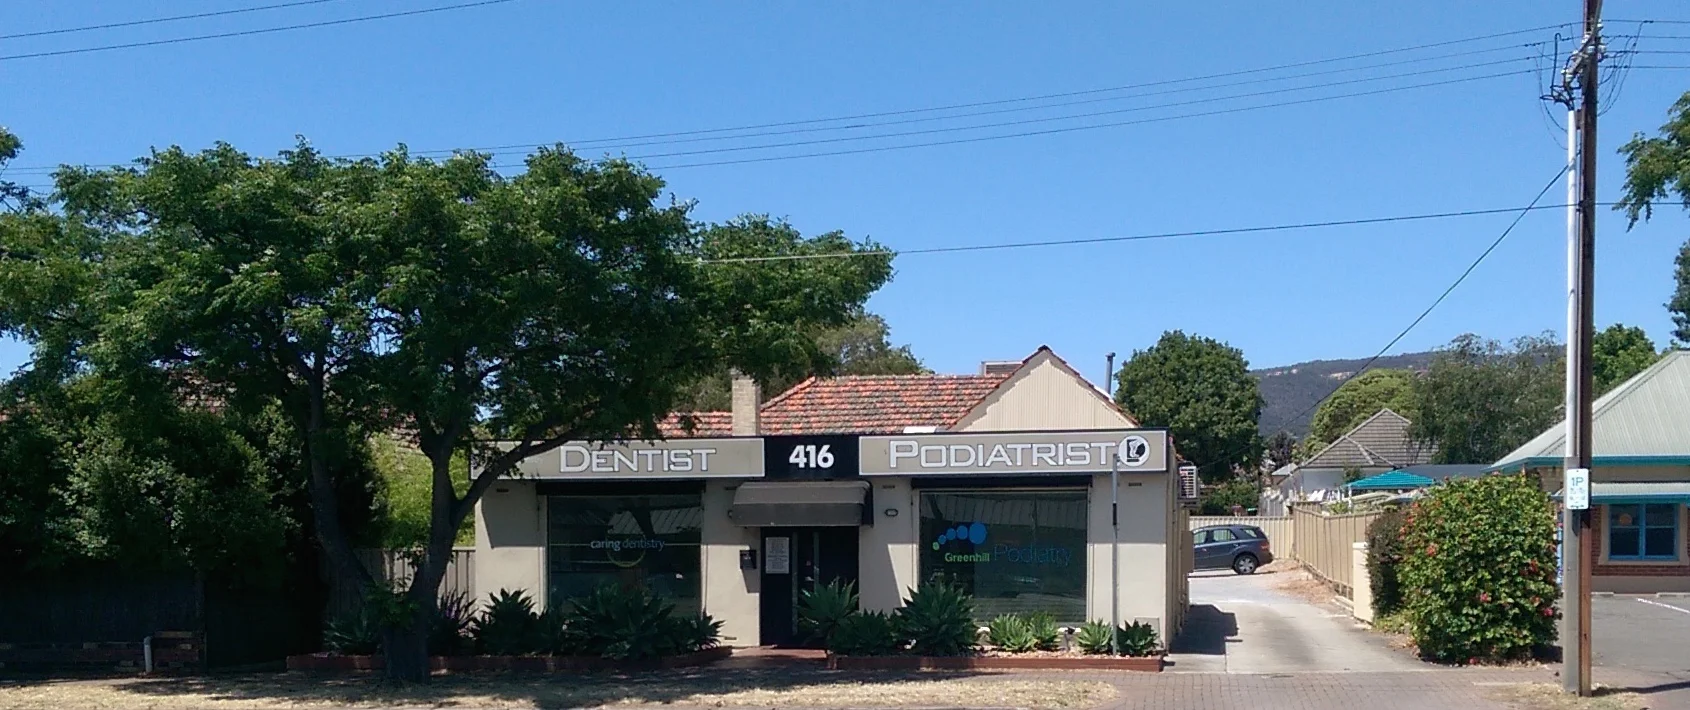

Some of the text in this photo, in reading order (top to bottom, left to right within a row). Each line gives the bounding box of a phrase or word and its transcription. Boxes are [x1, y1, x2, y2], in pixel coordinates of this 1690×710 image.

[559, 445, 717, 473] DENTIST
[788, 445, 835, 469] 416
[888, 440, 1118, 469] PODIATRIST
[1571, 476, 1584, 486] 1P
[590, 538, 665, 551] caring dentistry
[944, 543, 1071, 566] Greenhill Podiatry
